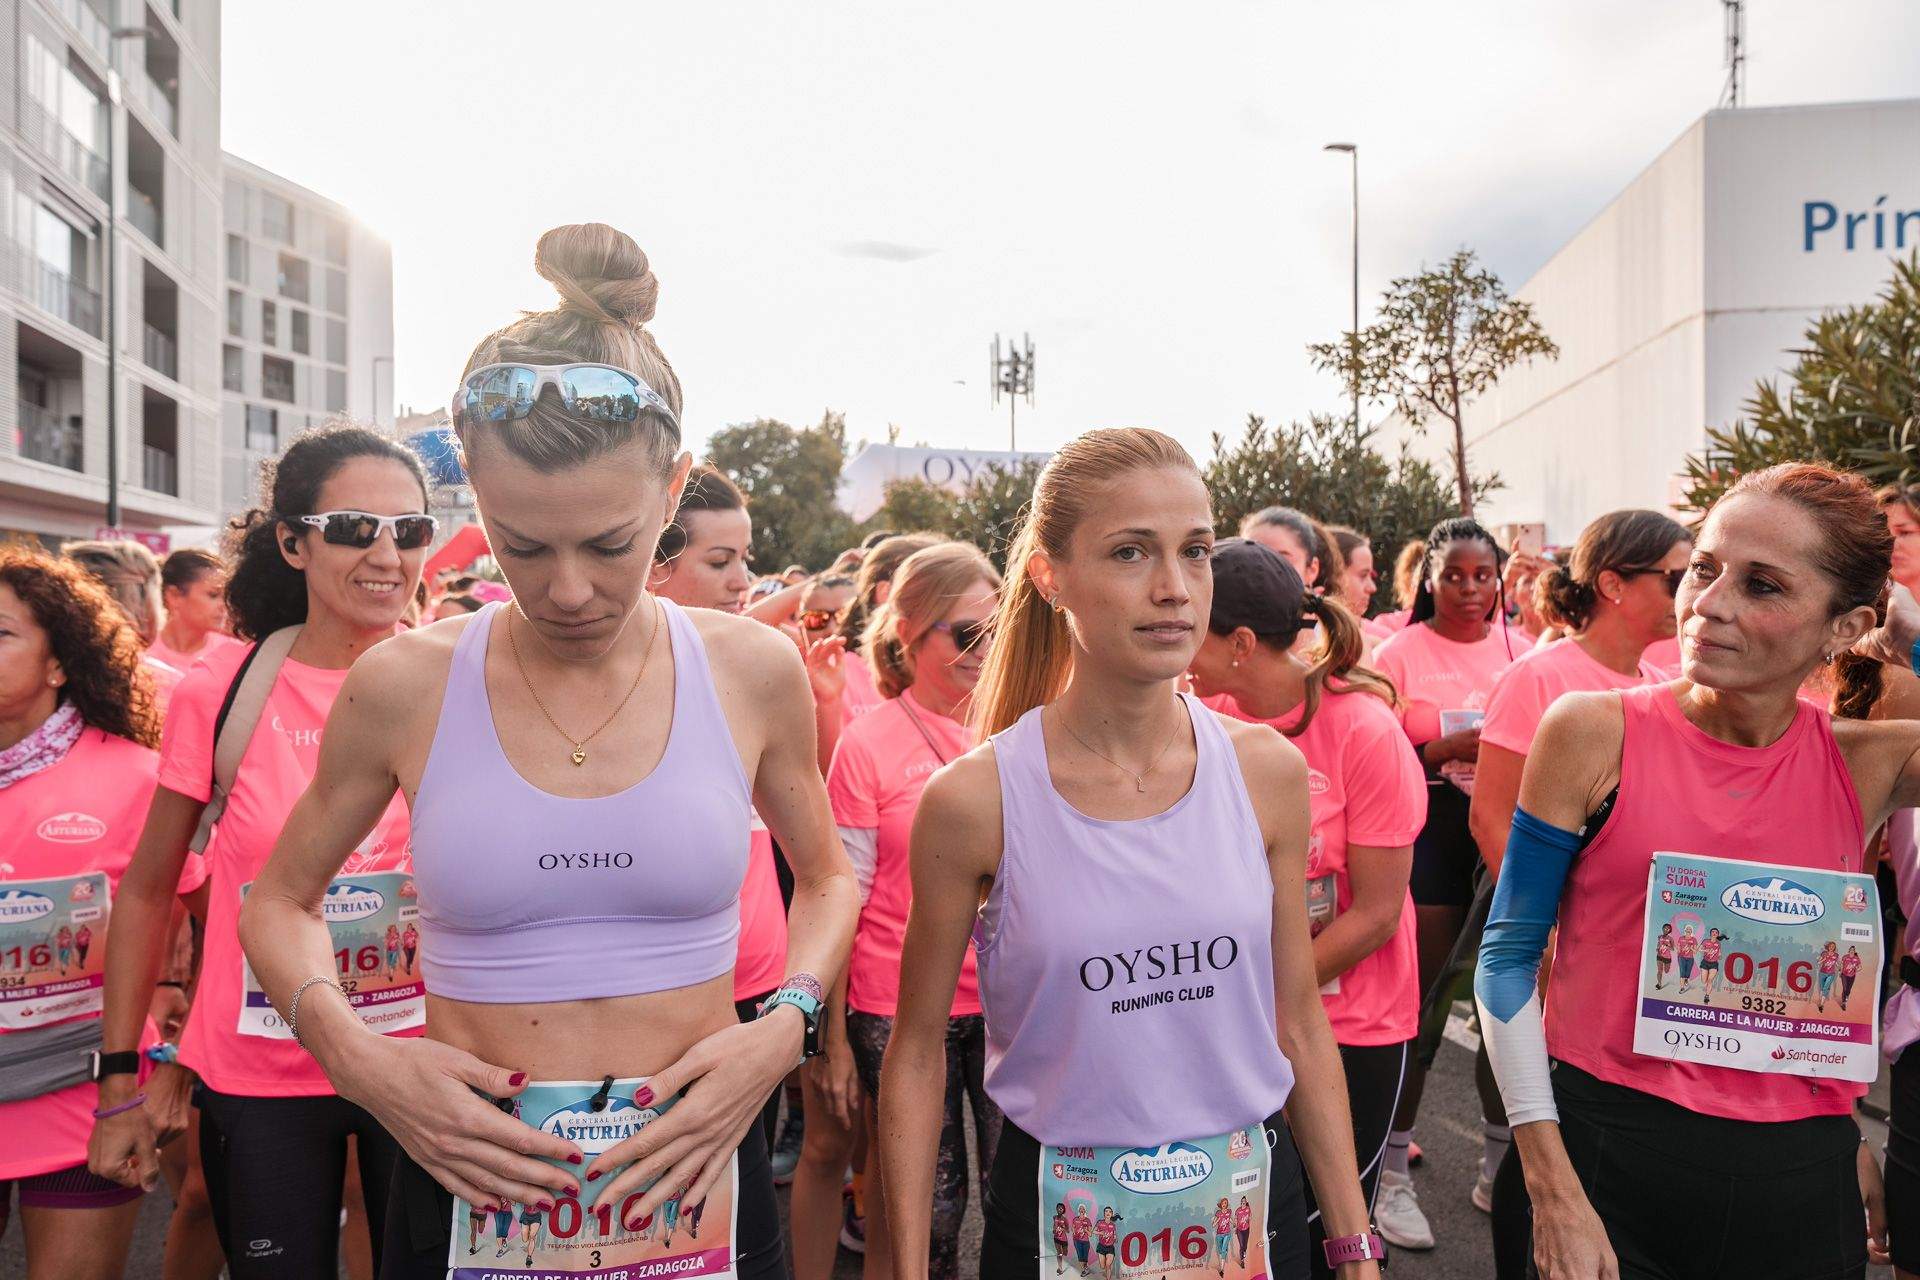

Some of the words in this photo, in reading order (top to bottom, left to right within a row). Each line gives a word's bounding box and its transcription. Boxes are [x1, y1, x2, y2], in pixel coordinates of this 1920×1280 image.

[538, 852, 633, 870] OYSHO
[1666, 873, 1706, 888] SUMA
[1675, 891, 1708, 902] Zaragoza
[1728, 889, 1818, 917] ASTURIANA
[0, 944, 52, 969] 16
[1080, 935, 1238, 991] OYSHO
[1724, 952, 1813, 993] 016
[372, 986, 417, 1002] ZARAGOZA
[1111, 990, 1174, 1014] RUNNING
[1178, 985, 1215, 1001] CLUB
[362, 1007, 416, 1025] Santander
[1741, 995, 1787, 1016] 9382
[1666, 1005, 1716, 1021] CARRERA
[1719, 1012, 1734, 1024] DE
[1737, 1014, 1751, 1026] LA
[1754, 1017, 1794, 1032] MUJER
[1800, 1022, 1850, 1037] ZARAGOZA
[1664, 1029, 1741, 1054] OYSHO
[1786, 1049, 1848, 1065] Santander
[568, 1116, 609, 1125] CENTRAL
[613, 1112, 652, 1124] LECHERA
[552, 1119, 652, 1140] ASTURIAN
[1057, 1146, 1095, 1160] SUMA
[1066, 1164, 1098, 1176] Zaragoza
[1118, 1160, 1207, 1183] ASTURIANA
[1121, 1225, 1208, 1268] 016
[589, 1250, 602, 1268] 3
[639, 1256, 705, 1278] ZARAGOZA
